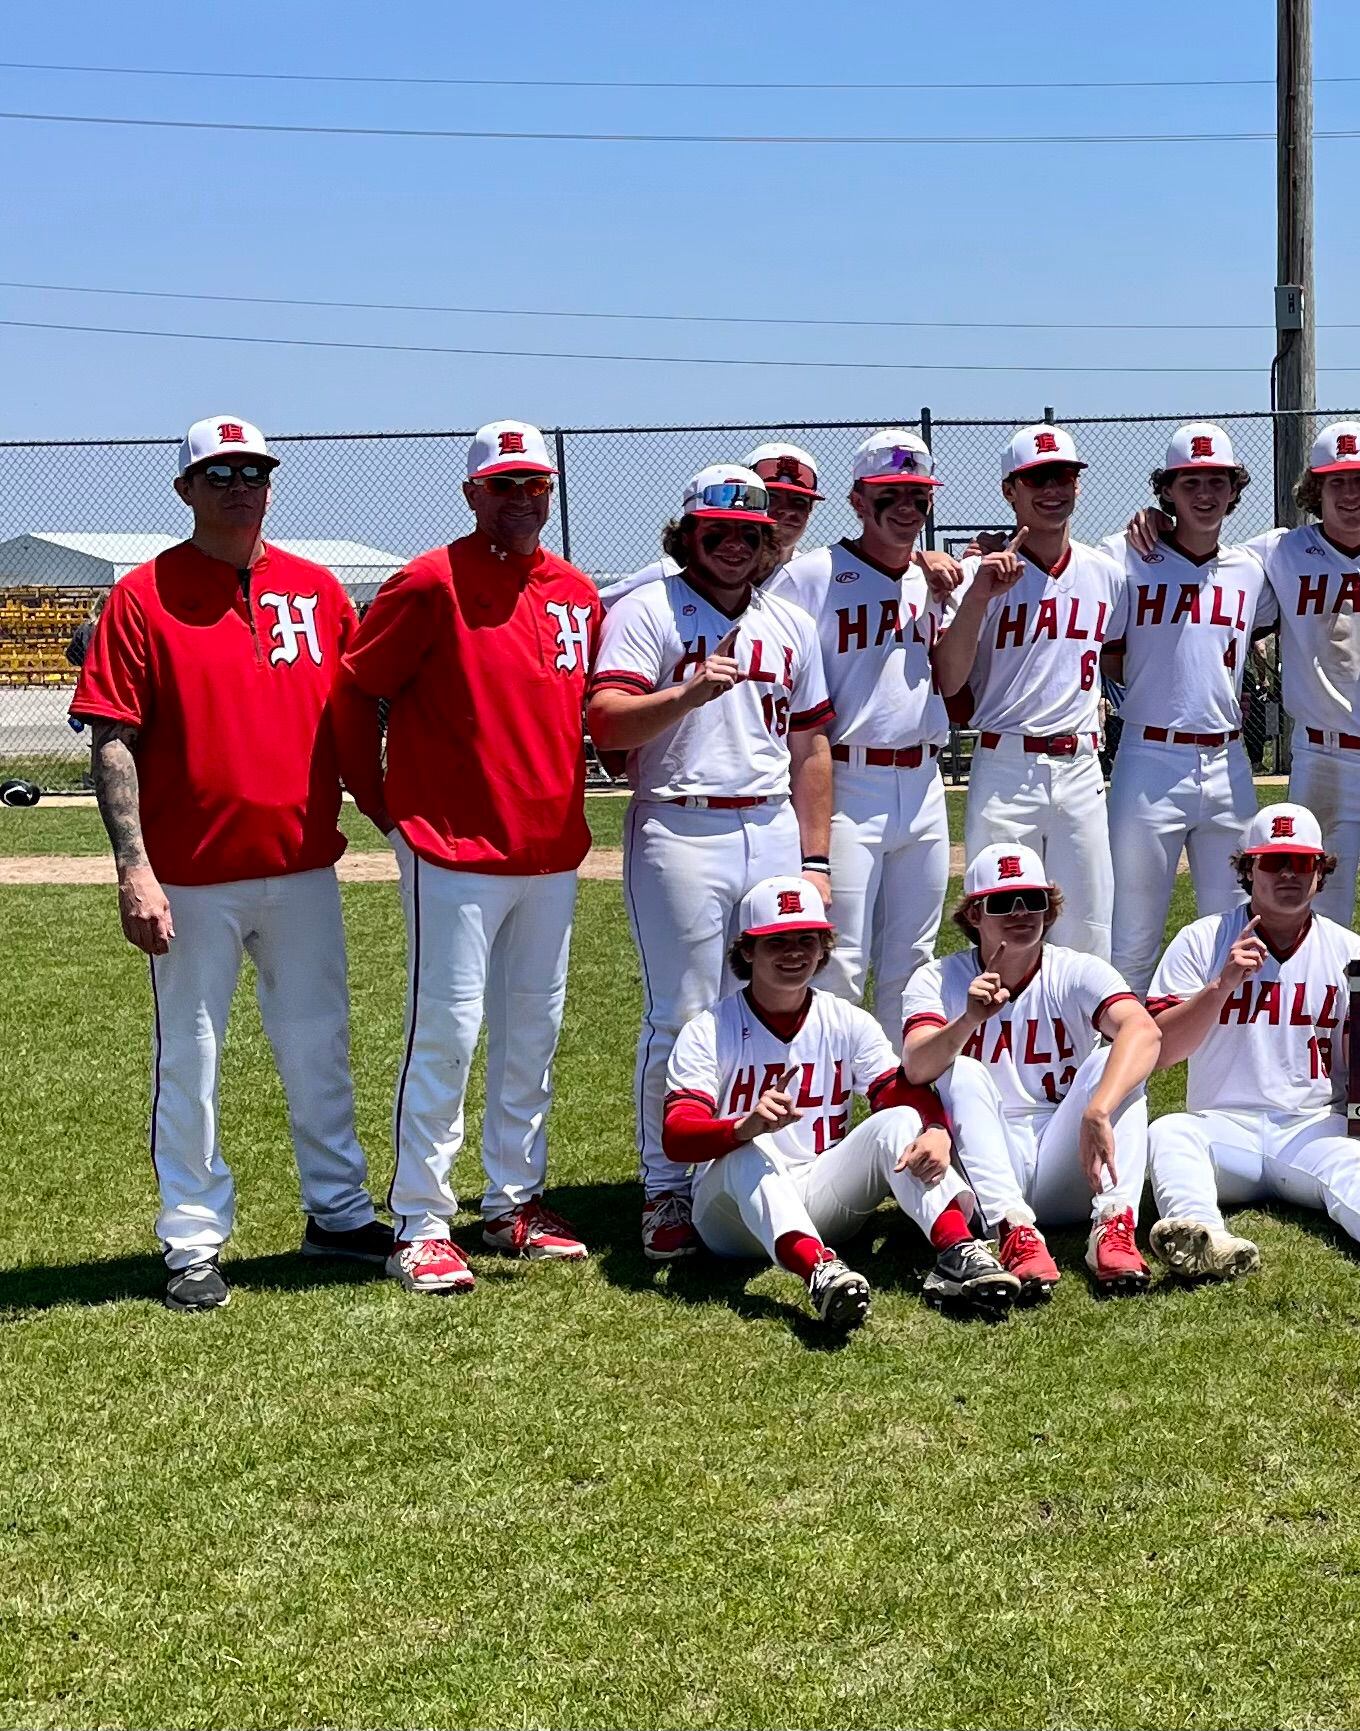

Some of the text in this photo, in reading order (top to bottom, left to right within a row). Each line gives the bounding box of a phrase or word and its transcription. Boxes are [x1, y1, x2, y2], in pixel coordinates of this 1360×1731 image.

[259, 592, 323, 667] H
[995, 597, 1106, 650] HALL
[1136, 583, 1246, 632] HALL
[546, 601, 591, 673] H
[1223, 637, 1237, 671] 4
[1081, 649, 1097, 692] 6
[1218, 980, 1340, 1029] HALL
[960, 1017, 1074, 1064] HALL
[728, 1059, 852, 1115] HALL
[812, 1110, 849, 1155] 15
